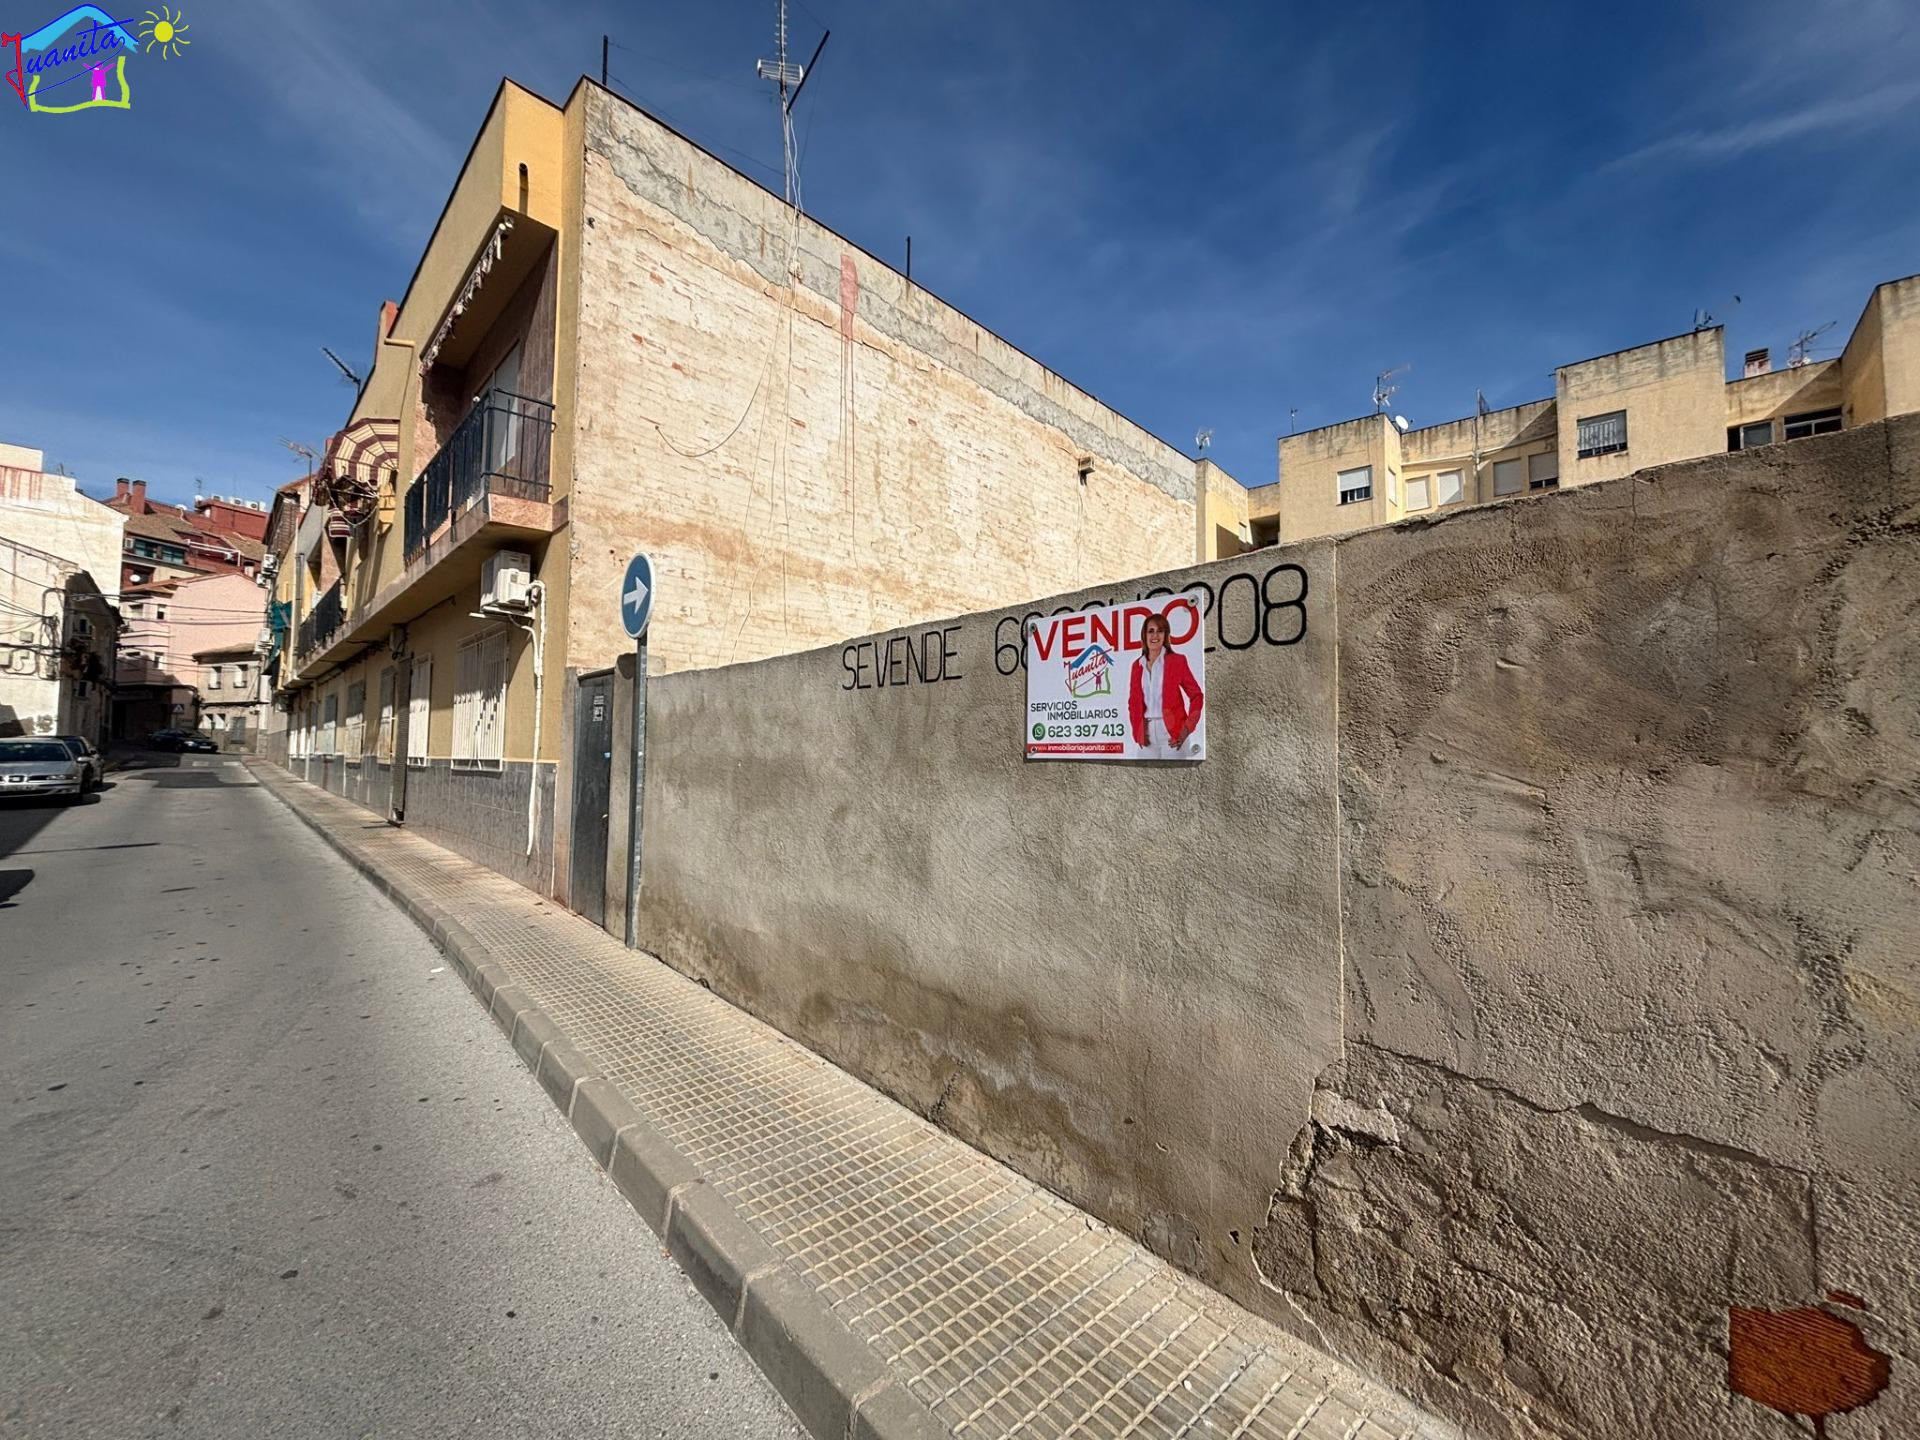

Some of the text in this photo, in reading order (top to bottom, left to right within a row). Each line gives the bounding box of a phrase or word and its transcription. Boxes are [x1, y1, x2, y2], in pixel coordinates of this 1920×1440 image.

[1032, 598, 1199, 661] VENDO
[1064, 648, 1112, 692] Juanita
[1030, 700, 1078, 712] SERVICIOS
[1047, 708, 1118, 720] INMOBILIARIOS
[1048, 723, 1125, 738] 623 397 413
